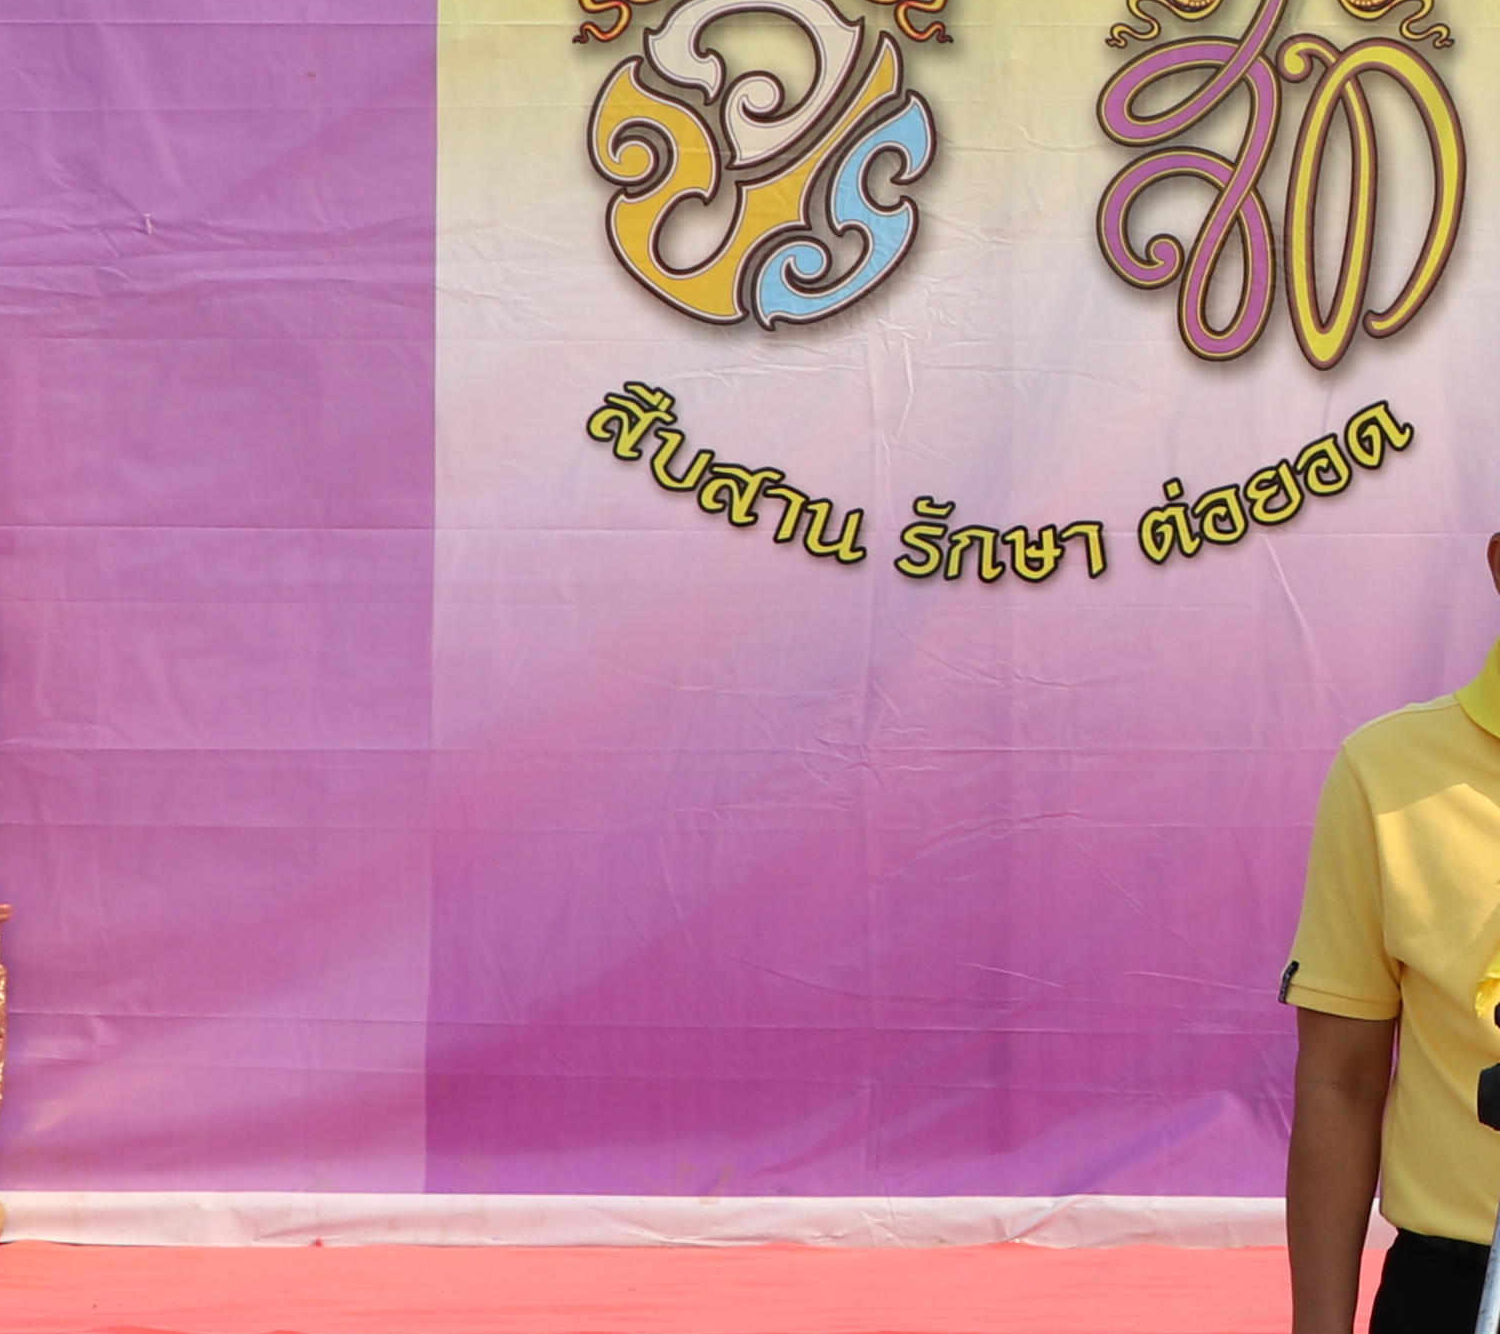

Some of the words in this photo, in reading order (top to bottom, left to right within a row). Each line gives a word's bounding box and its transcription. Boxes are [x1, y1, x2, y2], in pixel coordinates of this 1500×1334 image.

[586, 380, 867, 565] สืบสาน
[892, 496, 1108, 584] รักษา
[1137, 399, 1414, 567] ต่อยอด
